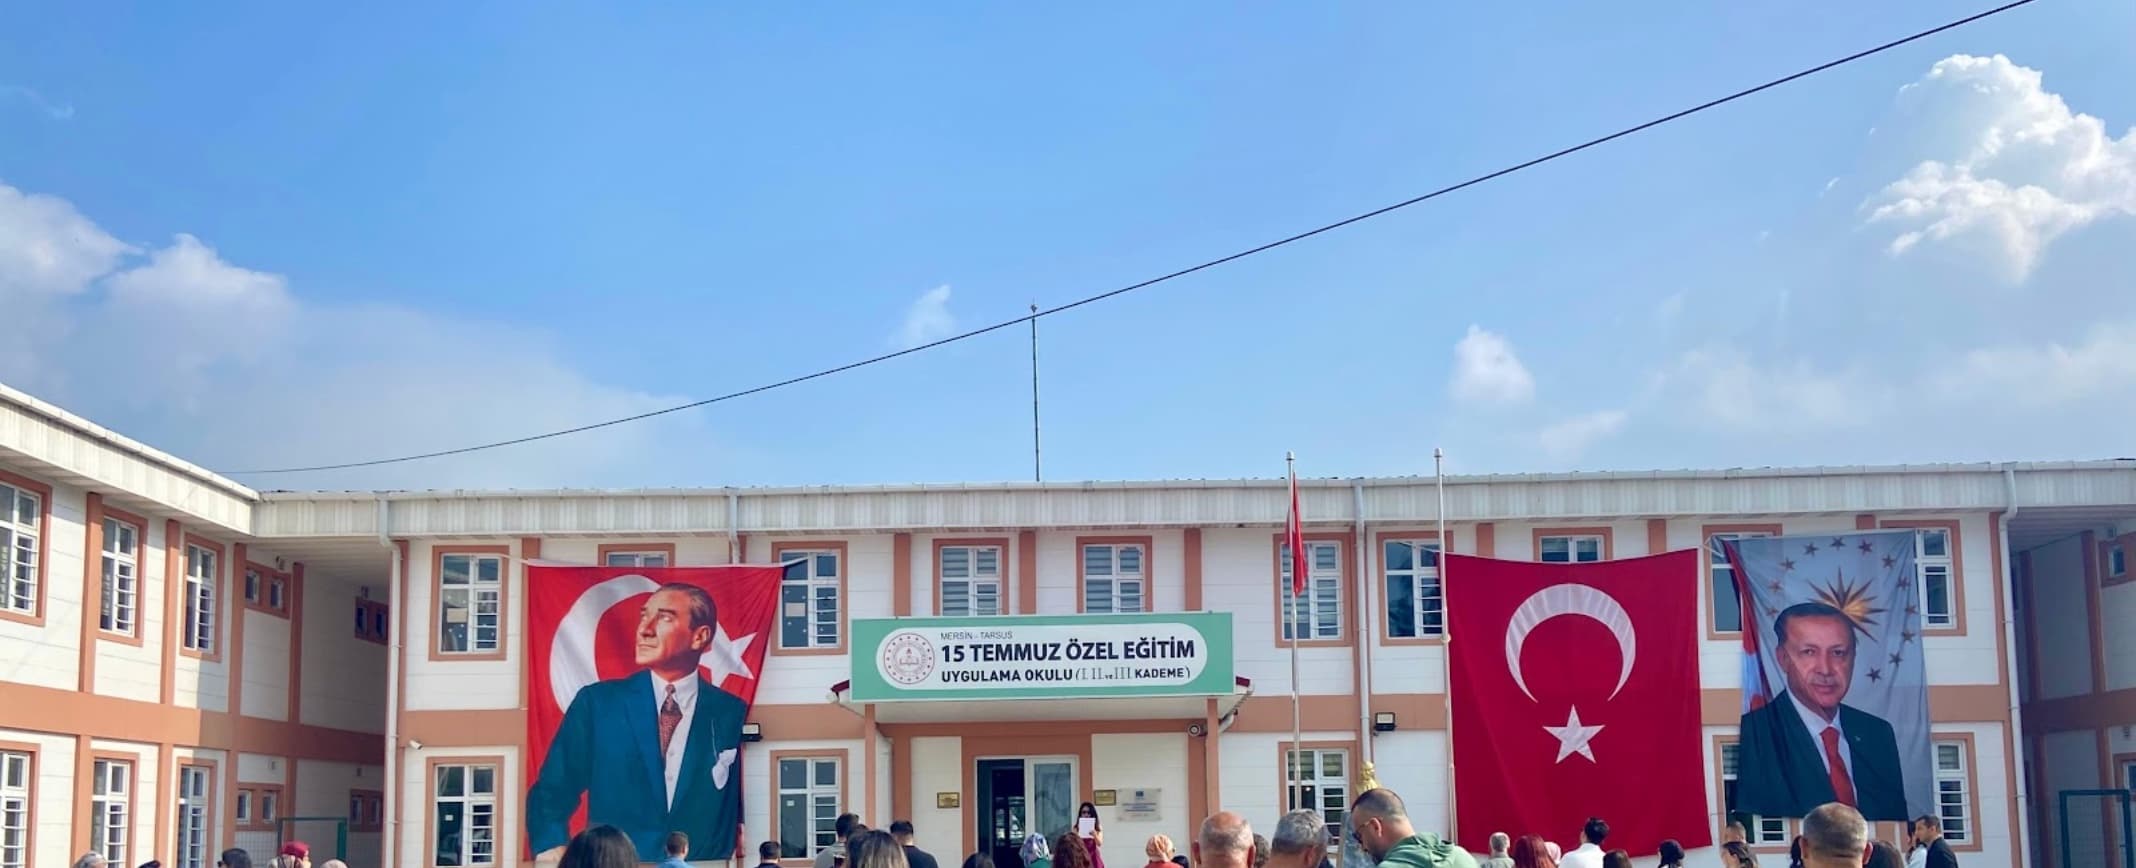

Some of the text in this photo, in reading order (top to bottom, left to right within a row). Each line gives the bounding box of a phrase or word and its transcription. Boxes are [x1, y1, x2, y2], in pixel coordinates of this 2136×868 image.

[942, 636, 1194, 662] 15 TEMMUZ ÖZEL EĞİTİM
[942, 670, 1021, 682] UYGULAMA
[1025, 669, 1073, 681] OKULU
